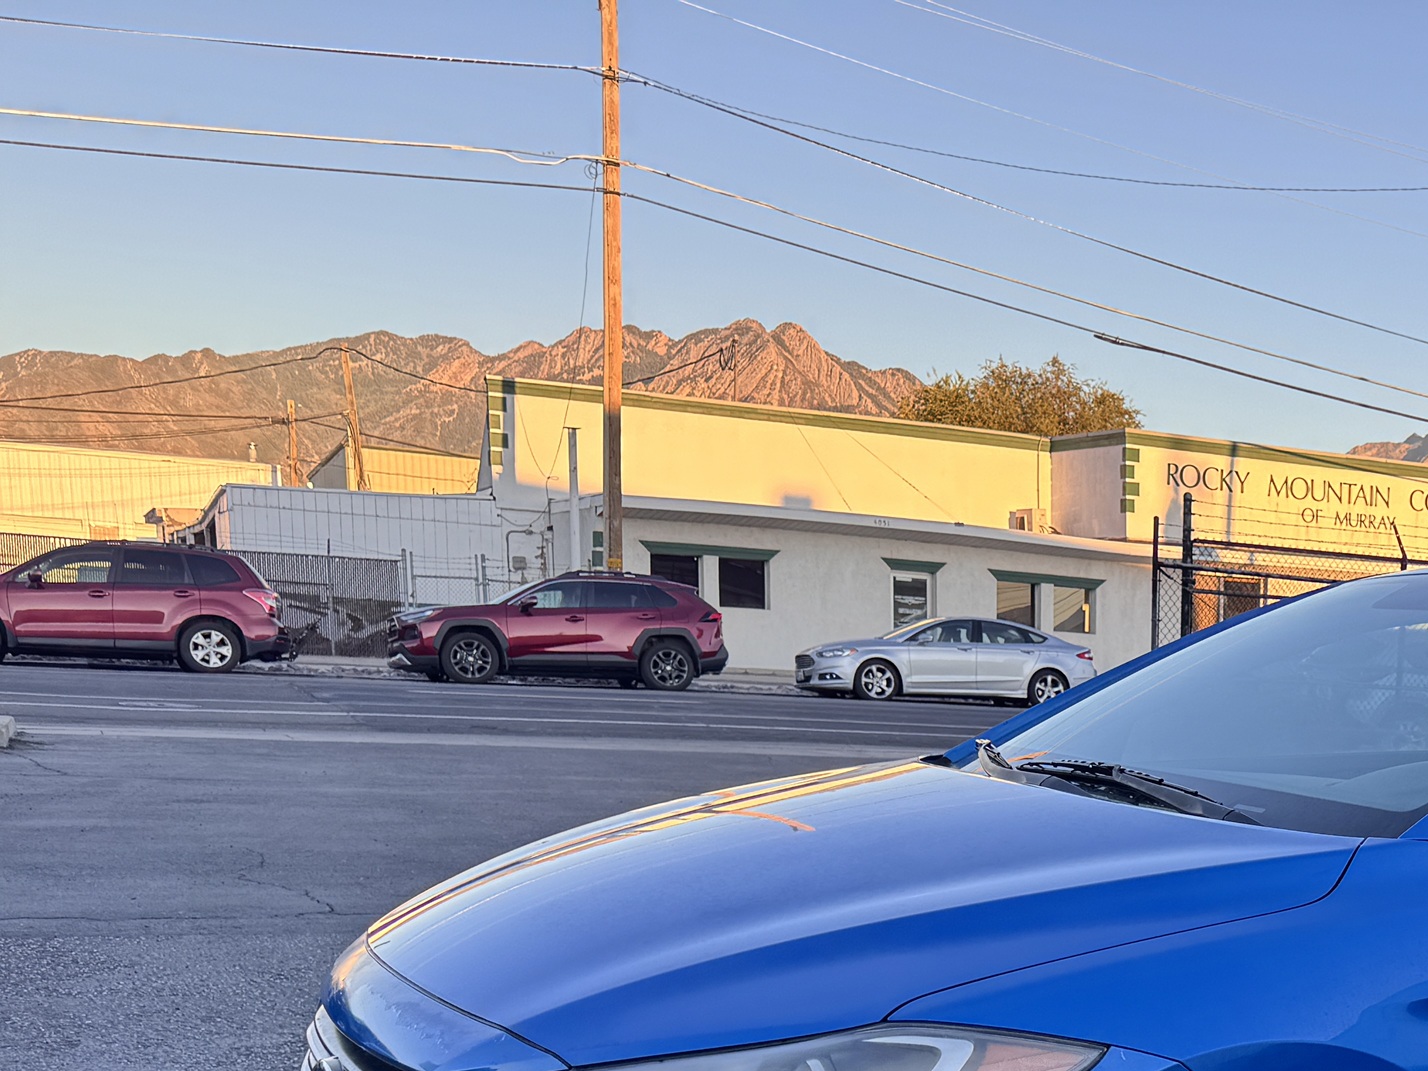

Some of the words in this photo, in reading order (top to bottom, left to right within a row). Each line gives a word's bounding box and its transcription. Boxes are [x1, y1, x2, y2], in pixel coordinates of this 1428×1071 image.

[1166, 461, 1250, 495] ROCKY
[1267, 473, 1391, 510] MOUNTAIN
[1301, 506, 1325, 525] OF
[1333, 511, 1396, 531] MURRAY
